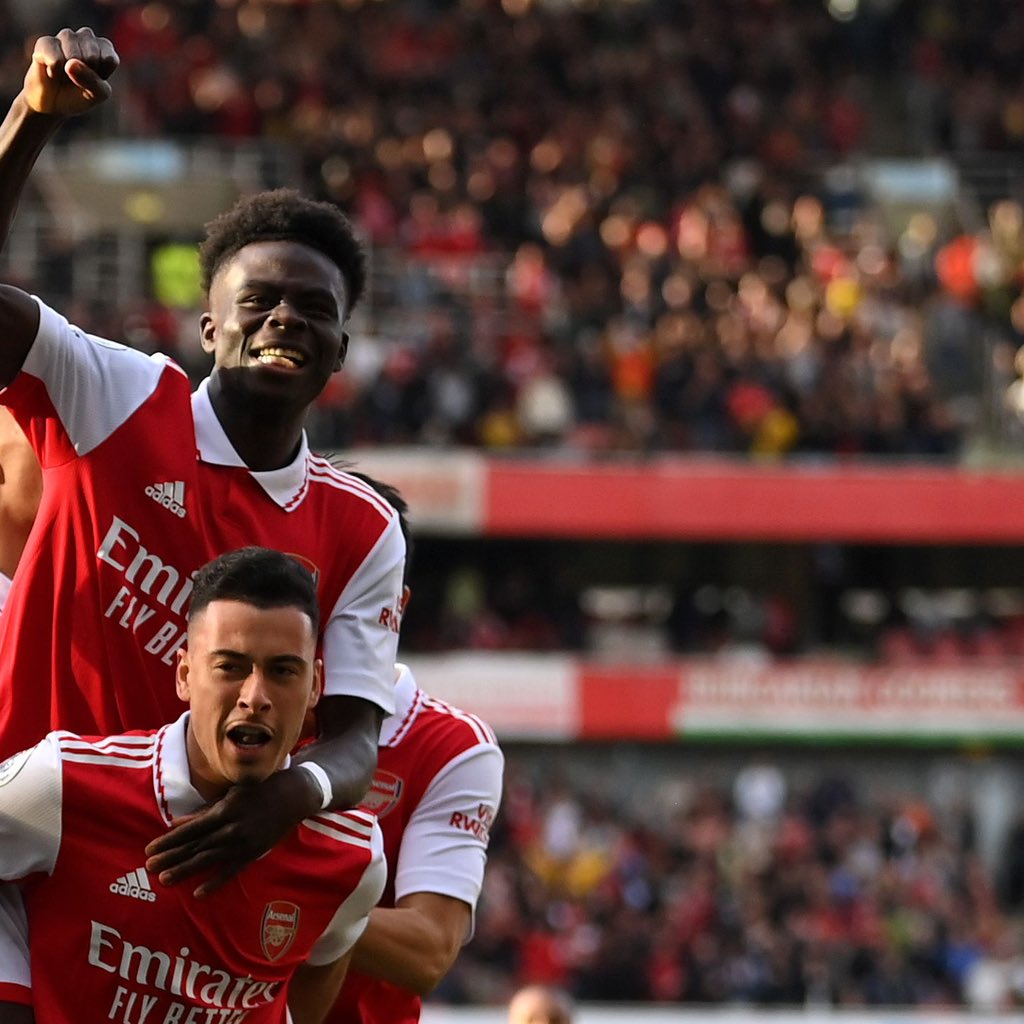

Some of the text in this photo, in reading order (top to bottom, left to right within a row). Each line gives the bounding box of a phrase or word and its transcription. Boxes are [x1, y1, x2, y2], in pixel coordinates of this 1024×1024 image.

[144, 485, 187, 518] adidas
[104, 585, 156, 634] FLY
[109, 882, 157, 902] adidas
[267, 910, 296, 922] Arsenal
